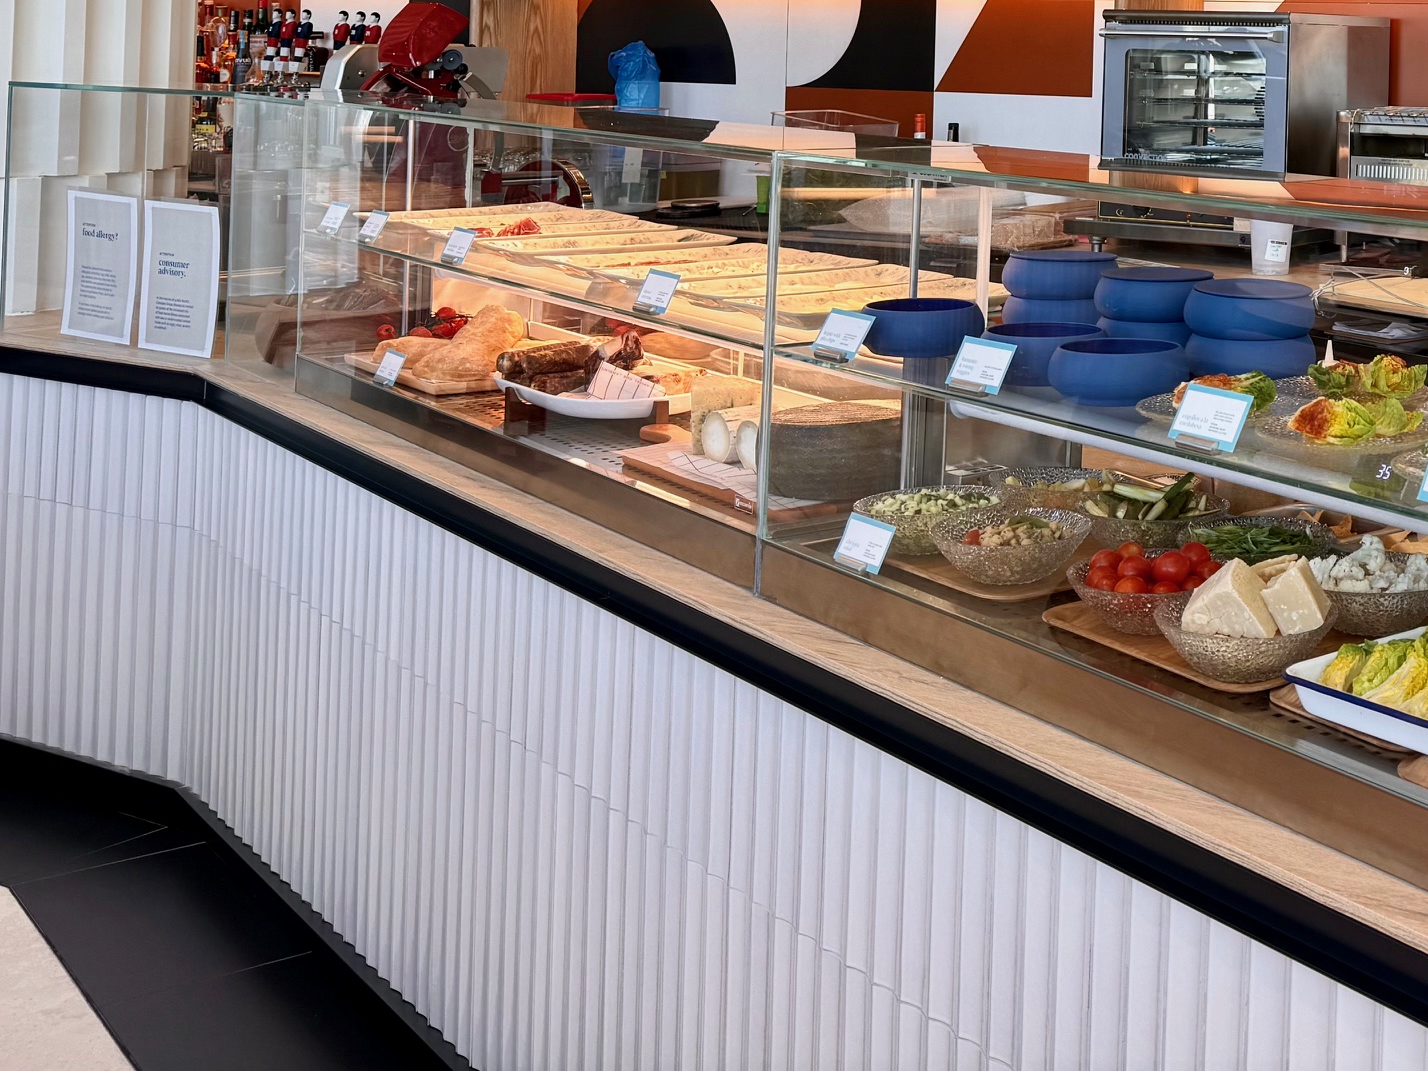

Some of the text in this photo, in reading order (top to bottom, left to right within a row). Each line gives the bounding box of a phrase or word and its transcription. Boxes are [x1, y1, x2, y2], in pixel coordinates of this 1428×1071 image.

[82, 228, 118, 241] food allergy?
[158, 259, 190, 269] consumer
[157, 267, 187, 279] advisory.
[1376, 464, 1392, 479] 35
